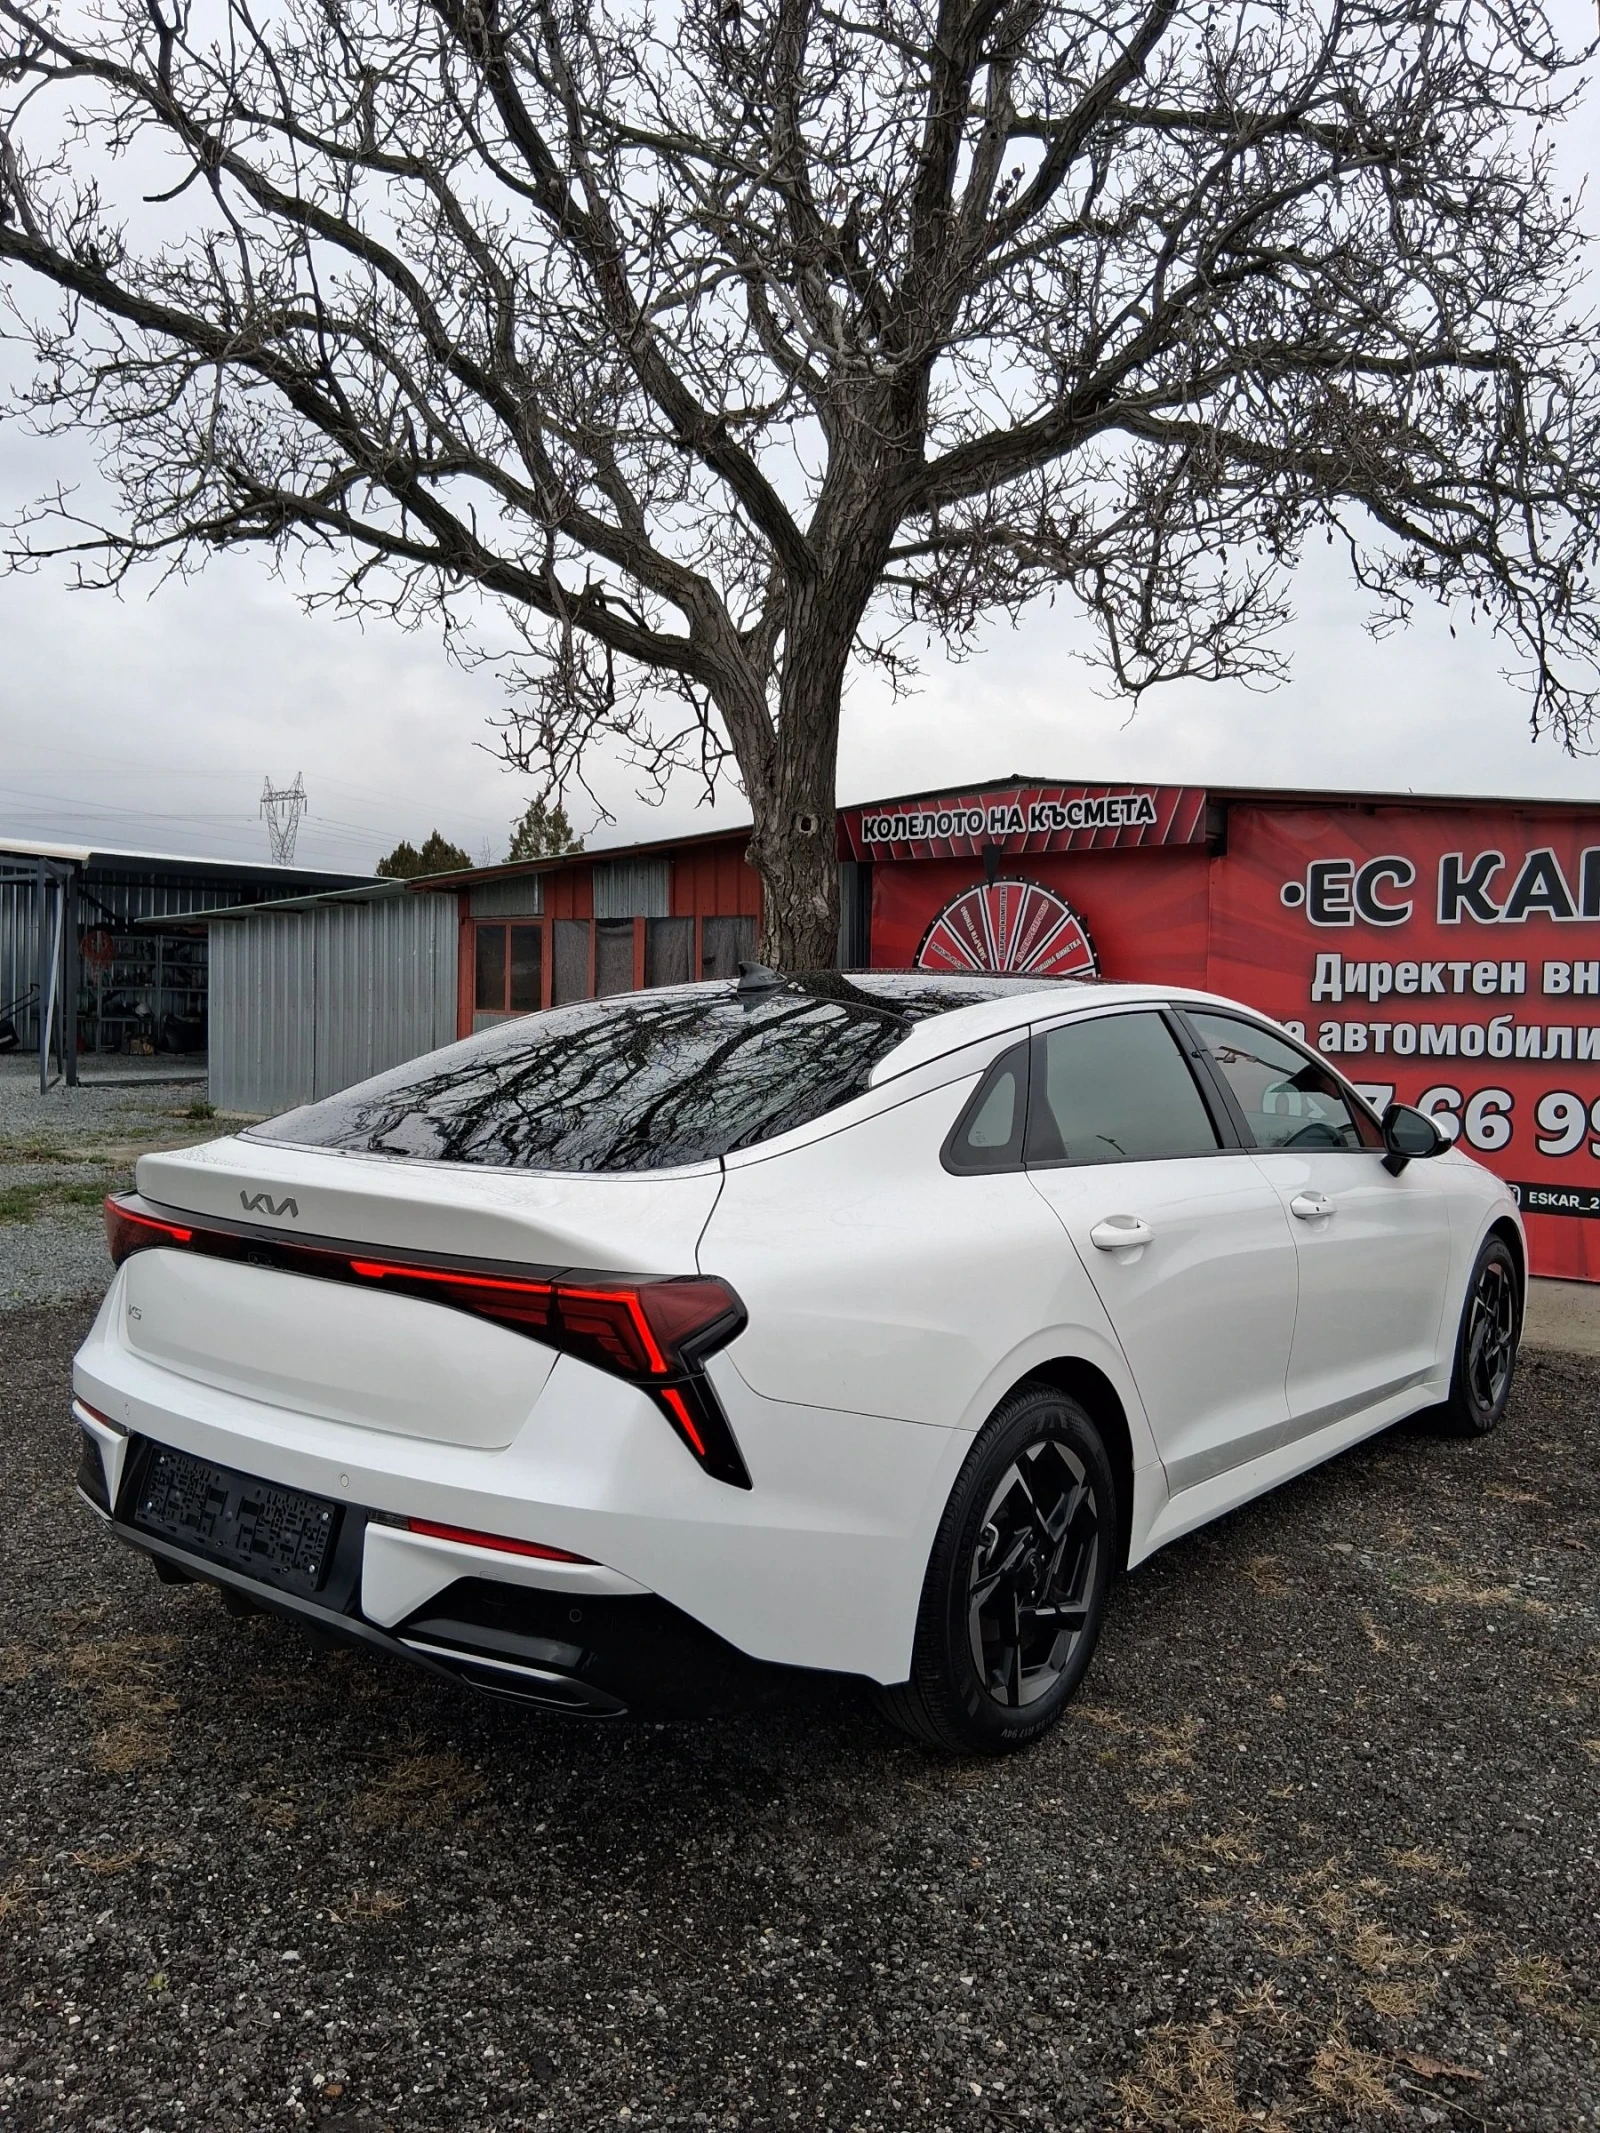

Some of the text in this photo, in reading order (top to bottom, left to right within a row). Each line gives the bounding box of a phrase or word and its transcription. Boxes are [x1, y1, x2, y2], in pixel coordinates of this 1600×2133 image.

[862, 794, 1158, 843] КОЛЕЛОТО НА КЪСМЕТА
[960, 906, 987, 961] ЗАВЪРТИ ОТНОВО
[1015, 936, 1032, 963] ПЪЛЕН
[1310, 952, 1526, 1002] Директен
[1318, 1014, 1600, 1060] автомобили
[1534, 1089, 1600, 1157] 9
[240, 1189, 299, 1218] KIA
[1528, 1191, 1600, 1211] ESKAR_2
